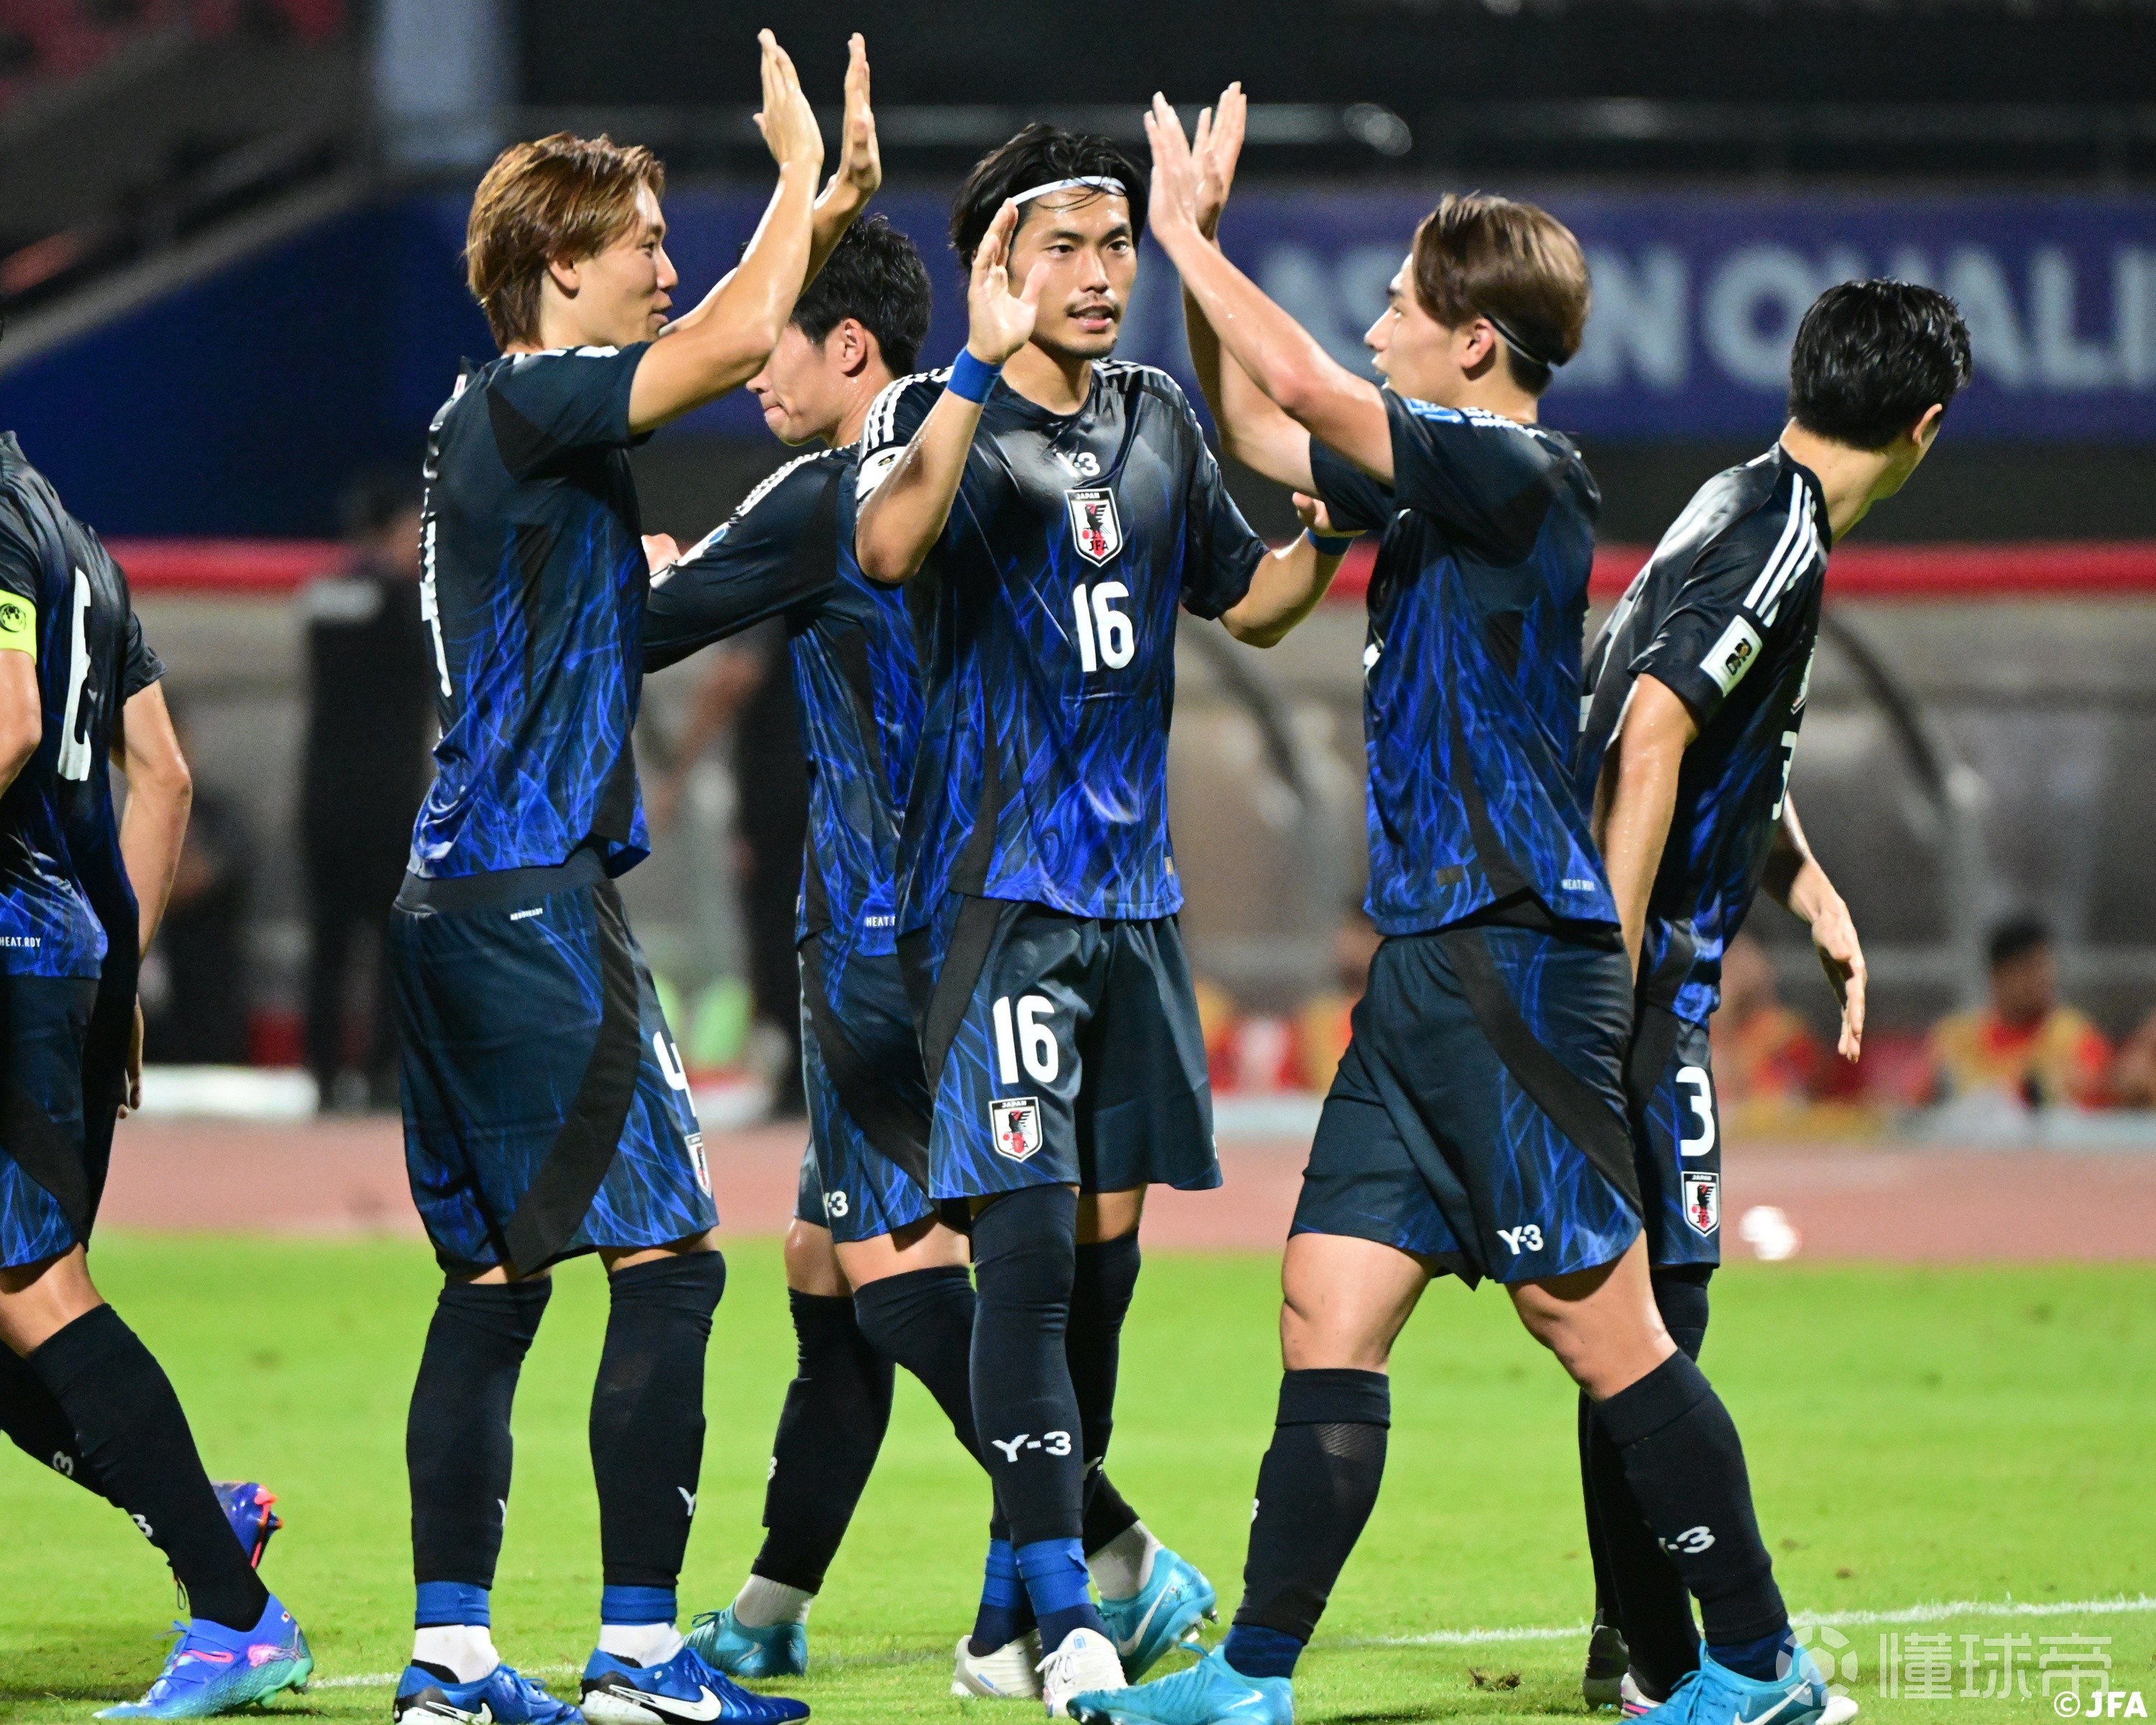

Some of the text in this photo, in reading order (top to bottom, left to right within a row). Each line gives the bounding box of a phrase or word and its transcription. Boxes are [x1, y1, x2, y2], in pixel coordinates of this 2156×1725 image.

[1056, 451, 1100, 477] Y-3
[1089, 540, 1110, 552] JFA
[1072, 581, 1135, 673] 16
[992, 995, 1059, 1084] 16
[1675, 1066, 1715, 1156] 3
[1496, 1224, 1544, 1255] Y-3
[992, 1430, 1072, 1463] Y-3
